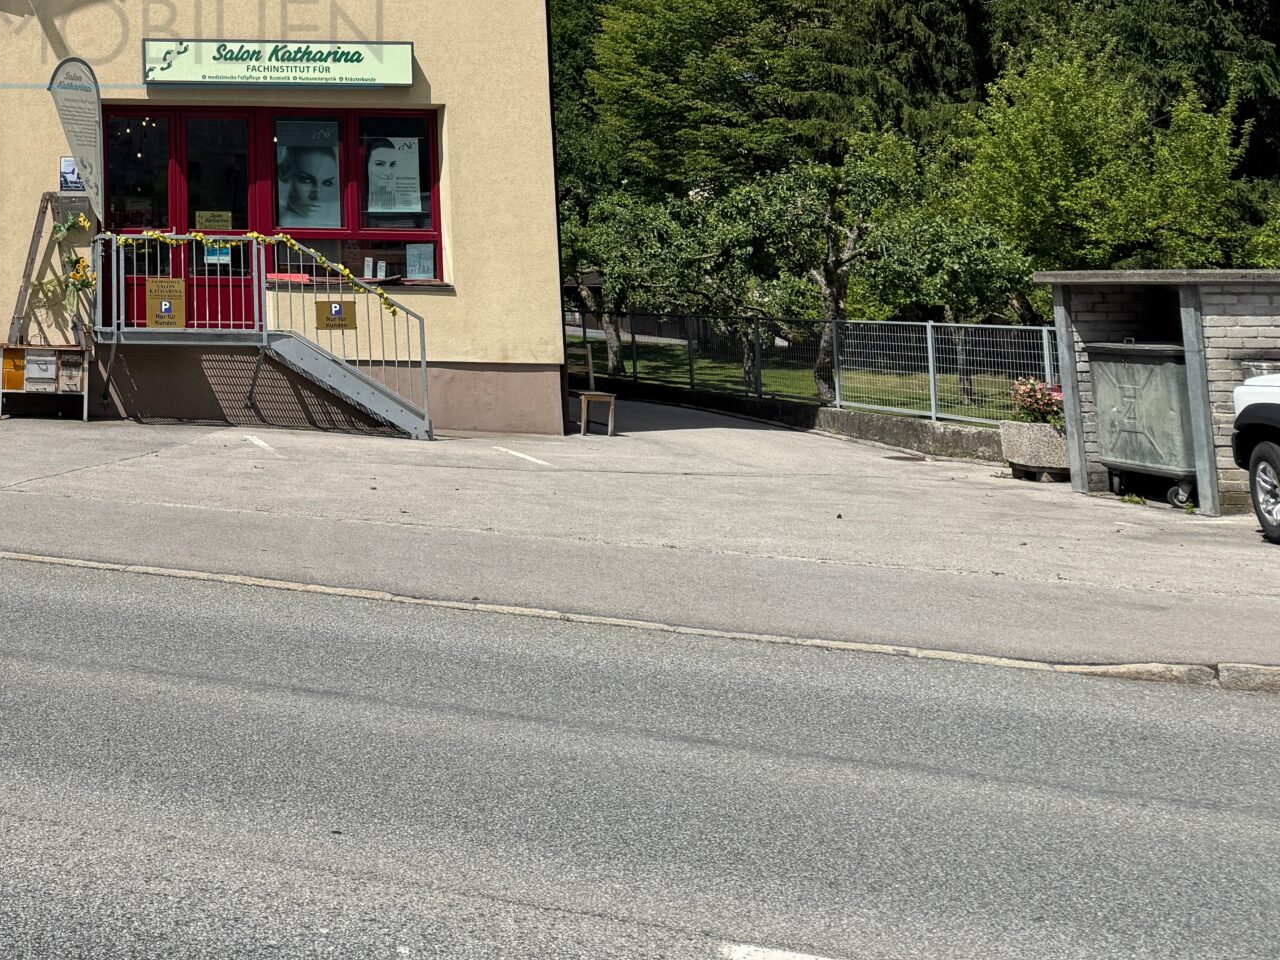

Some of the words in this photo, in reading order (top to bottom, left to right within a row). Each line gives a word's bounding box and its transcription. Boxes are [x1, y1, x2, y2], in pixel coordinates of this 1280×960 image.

[212, 43, 262, 63] Salon
[267, 44, 364, 64] Katharina
[246, 65, 311, 73] FACHINSTITUT
[313, 64, 331, 74] FÜR
[63, 71, 82, 81] Salon
[161, 301, 170, 312] P
[331, 303, 340, 315] P
